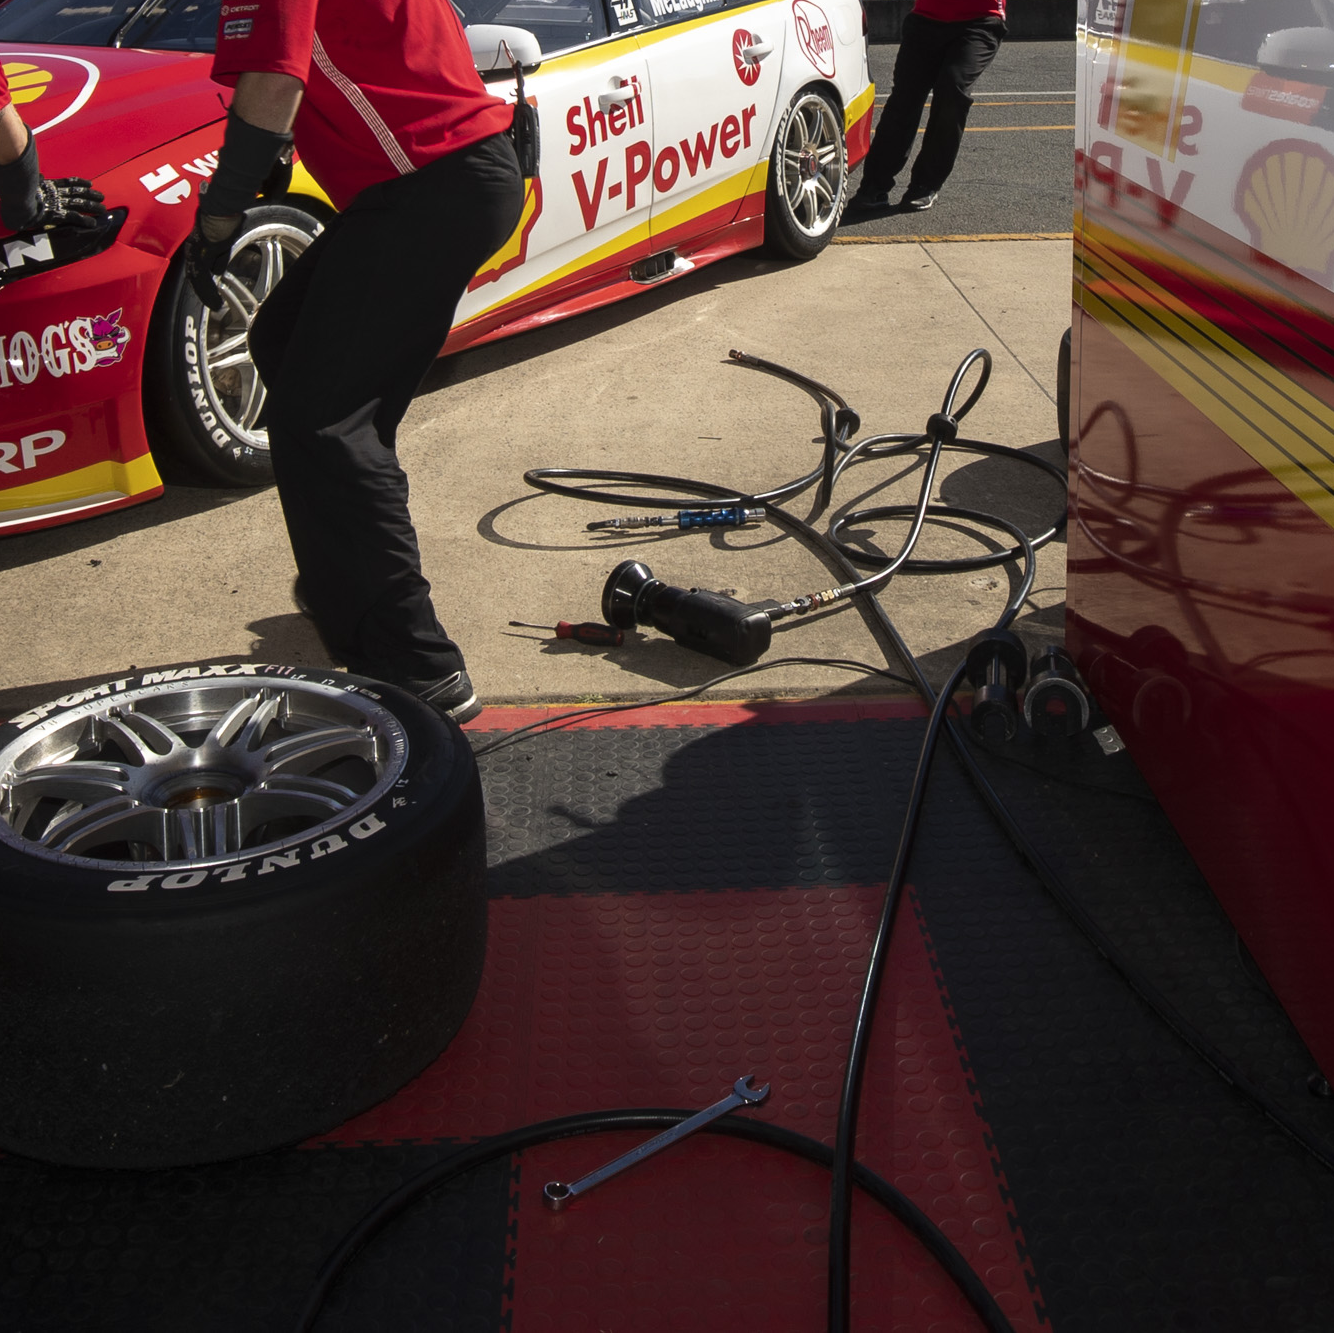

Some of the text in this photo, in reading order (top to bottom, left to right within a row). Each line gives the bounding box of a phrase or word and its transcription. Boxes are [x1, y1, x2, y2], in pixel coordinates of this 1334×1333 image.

[567, 75, 644, 156] Shell
[571, 104, 757, 232] V-Power
[185, 315, 231, 448] DUNLOP
[9, 664, 269, 730] SPORT MAXX
[107, 812, 388, 892] DUNLOP
